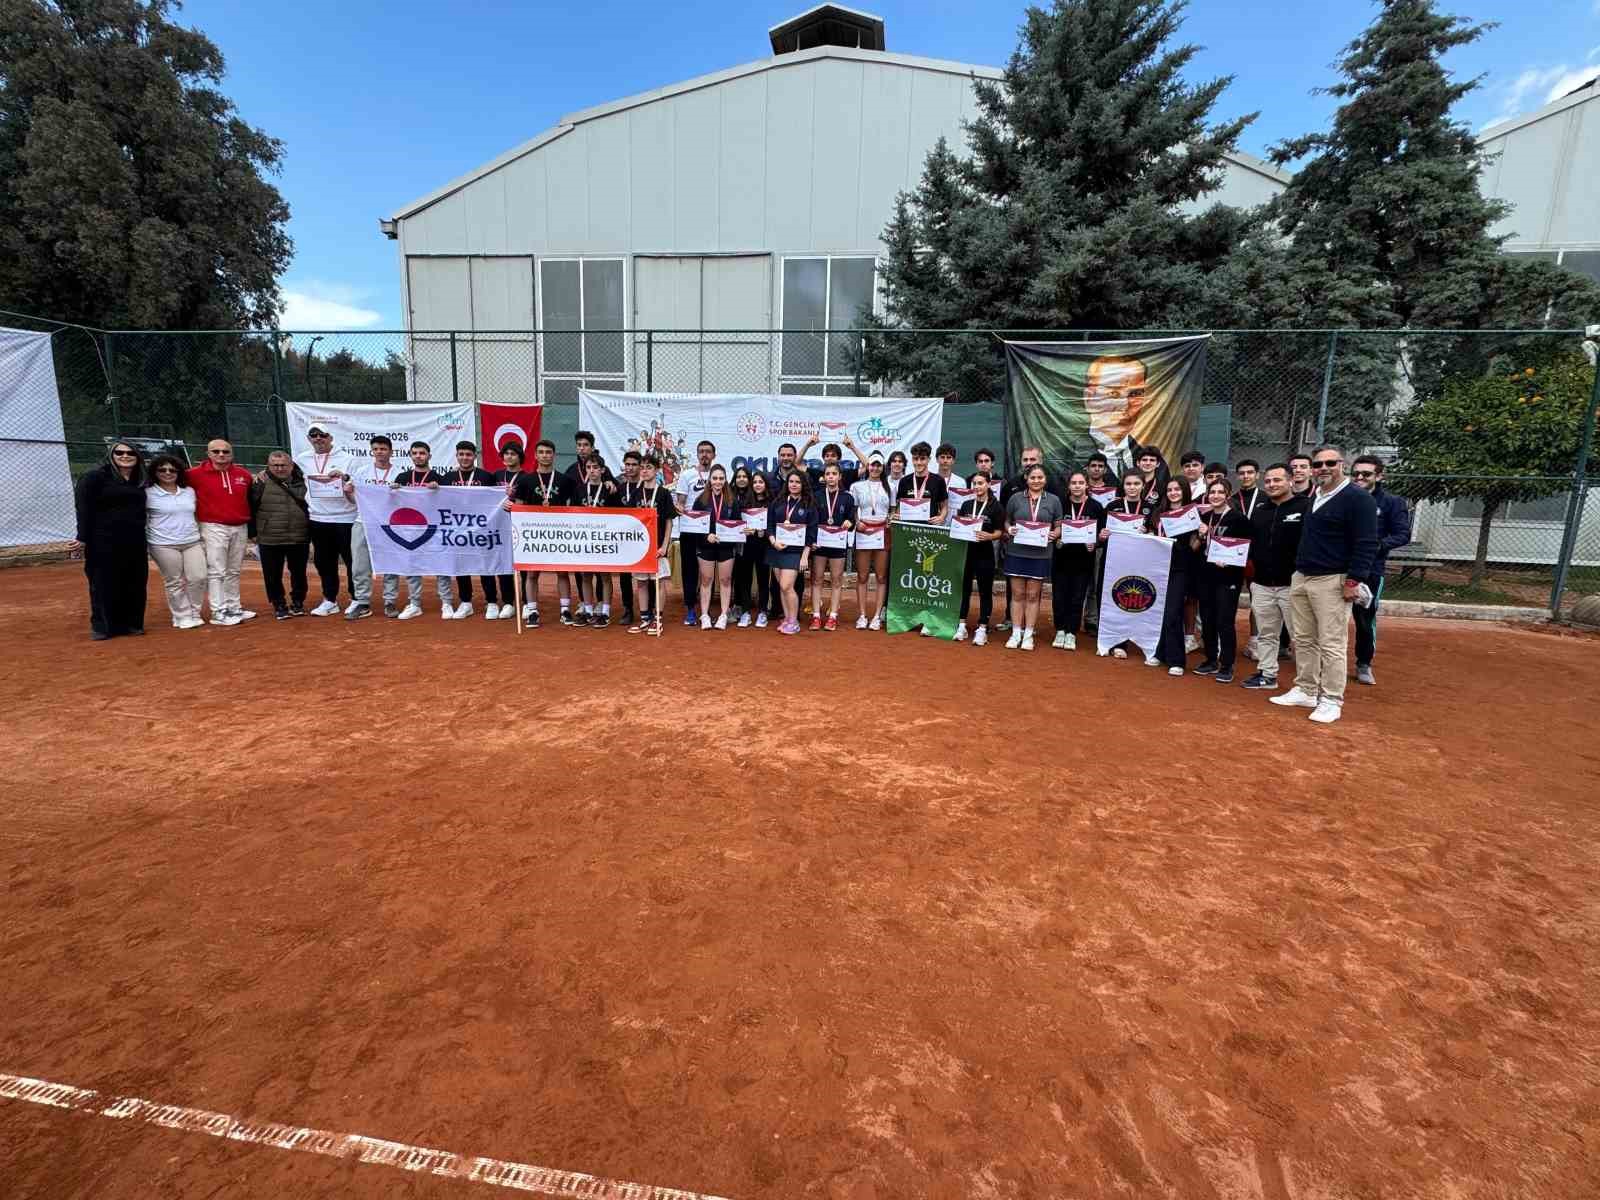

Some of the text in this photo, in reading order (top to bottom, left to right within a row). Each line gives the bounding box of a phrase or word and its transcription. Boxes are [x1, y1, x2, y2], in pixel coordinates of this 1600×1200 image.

[353, 432, 409, 442] 2025 2026
[438, 509, 487, 527] Evre
[441, 529, 502, 550] Koleji
[522, 529, 644, 541] ÇUKUROVA ELEKTRİK
[522, 542, 619, 554] ANADOLU LİSESİ
[900, 568, 952, 598] doğa
[902, 595, 952, 609] OKULLARI
